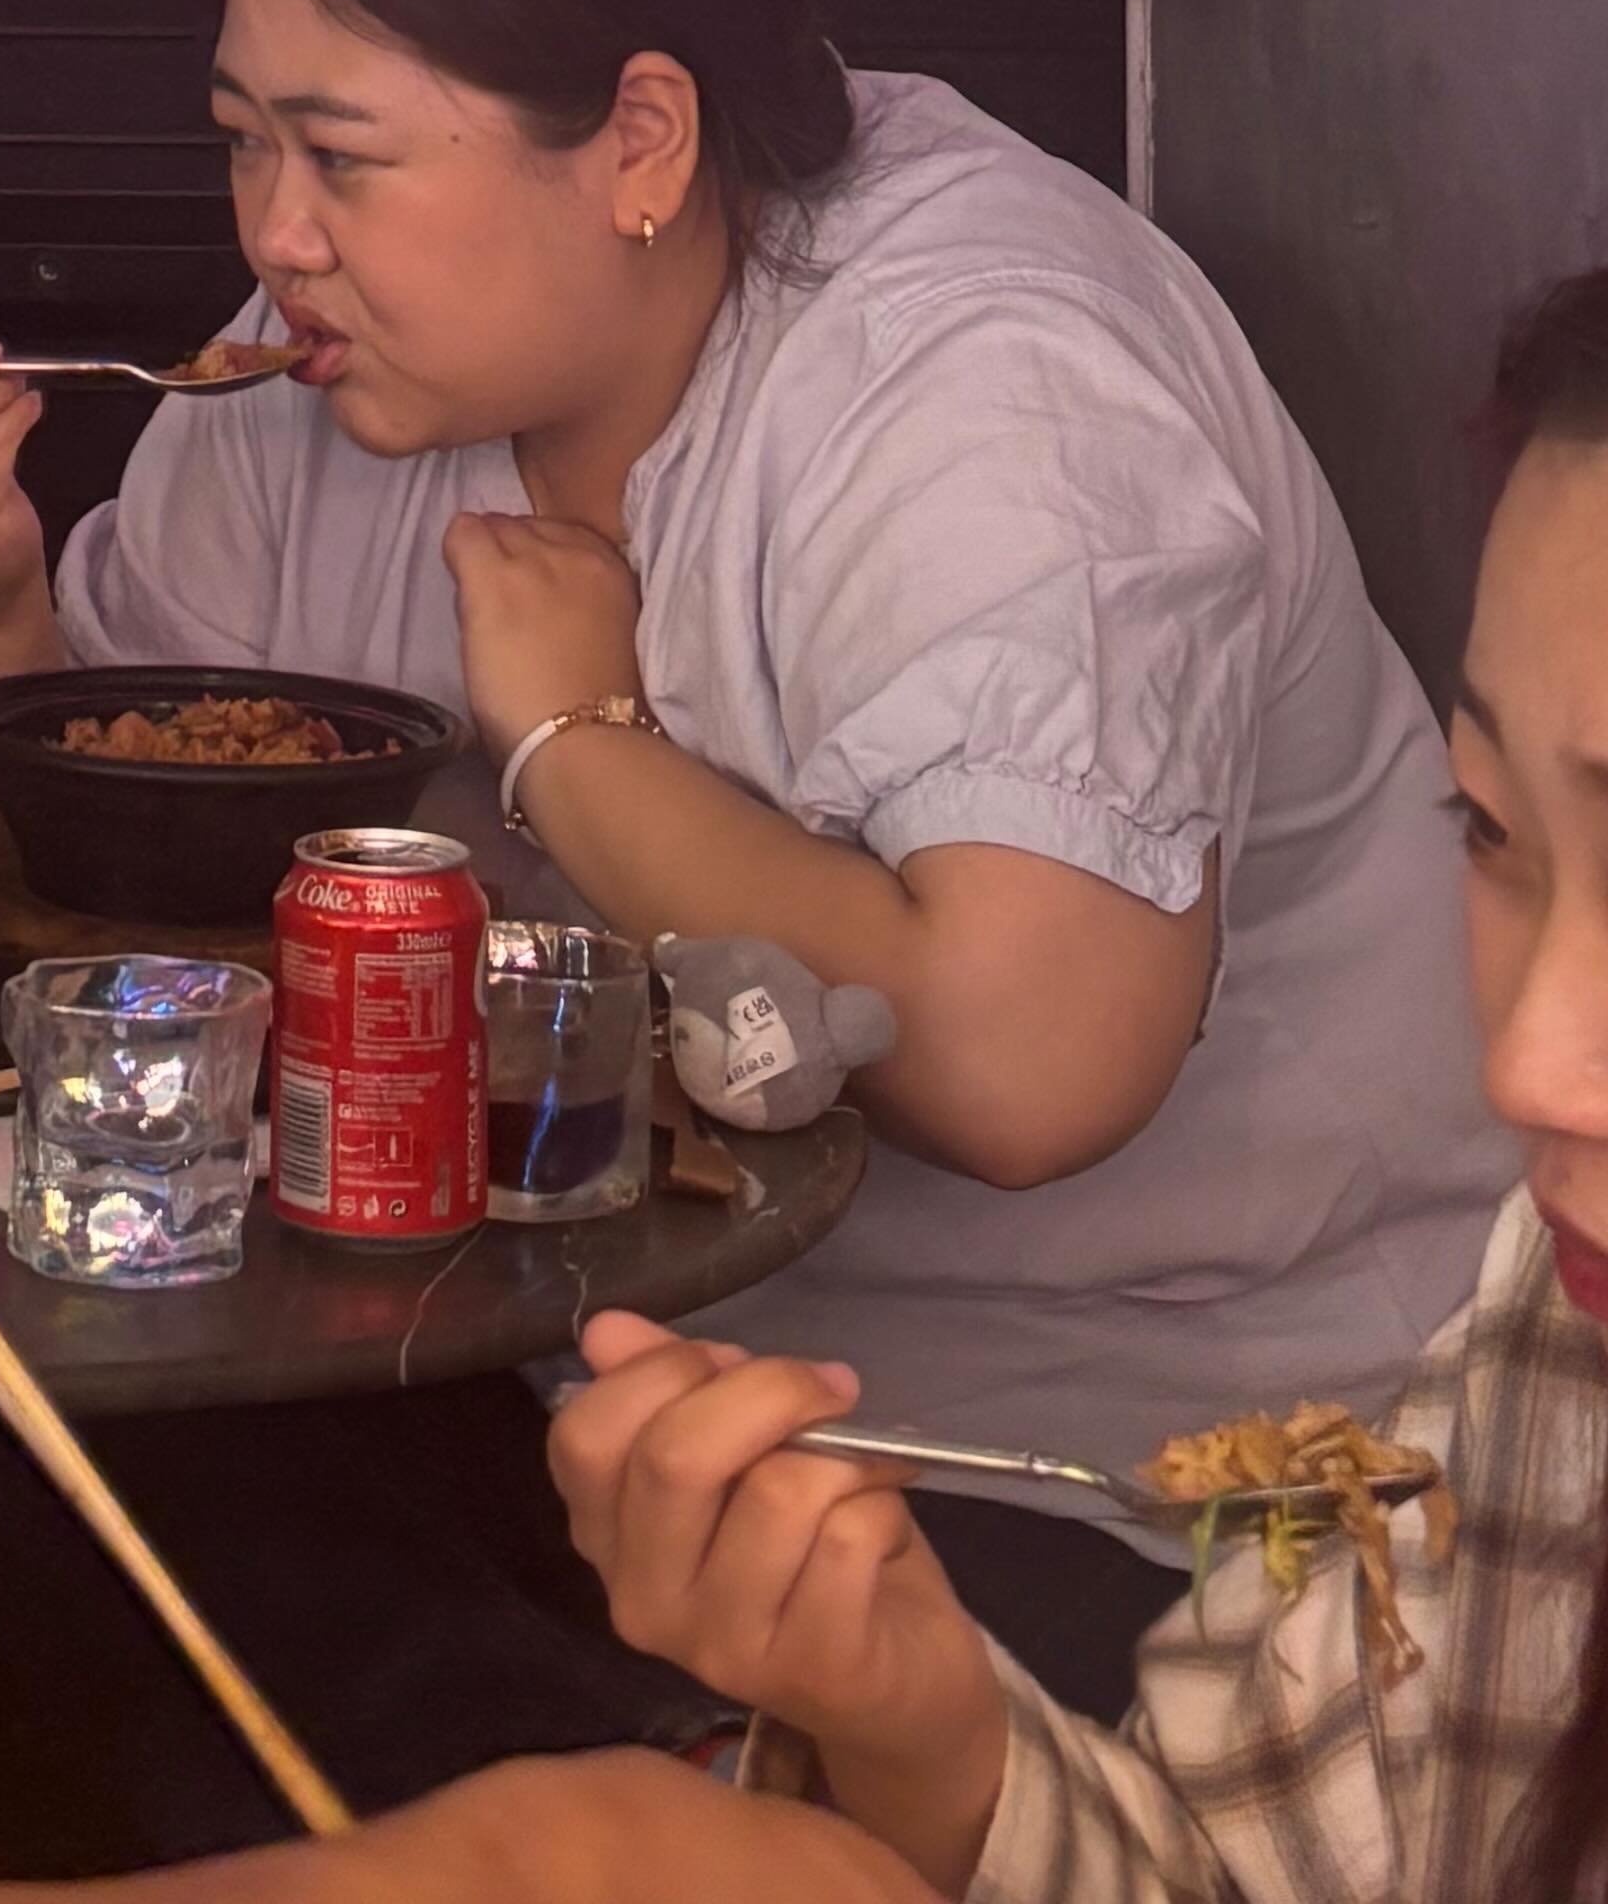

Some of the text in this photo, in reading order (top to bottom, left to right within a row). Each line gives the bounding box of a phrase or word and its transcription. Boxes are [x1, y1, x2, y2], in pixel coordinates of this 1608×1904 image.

[296, 873, 443, 912] Coke ORIGINAL
[365, 899, 422, 915] TASTE
